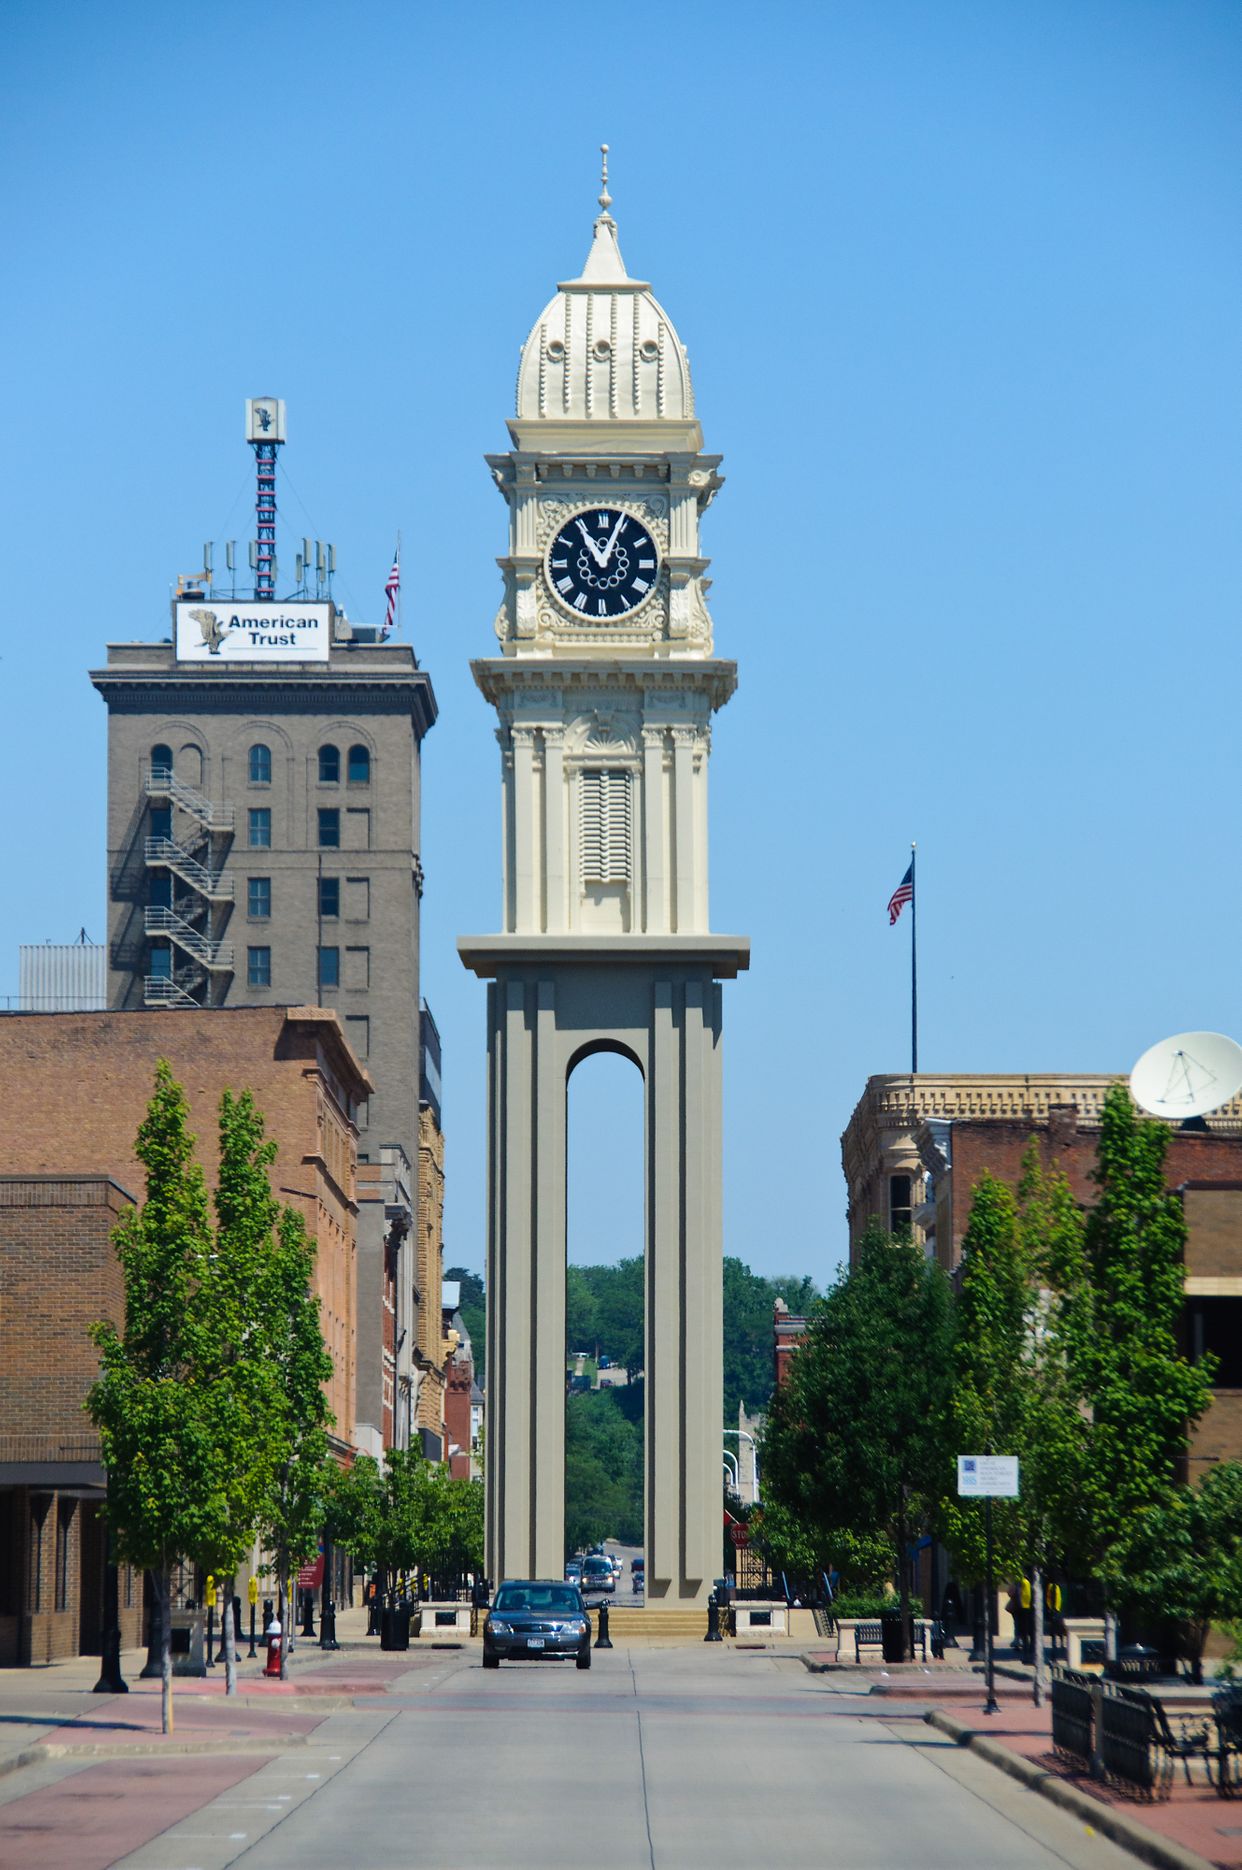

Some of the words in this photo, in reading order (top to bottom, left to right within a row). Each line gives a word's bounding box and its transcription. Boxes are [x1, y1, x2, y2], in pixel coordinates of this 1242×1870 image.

[597, 512, 609, 528] XII
[558, 535, 573, 548] X
[633, 536, 647, 548] II
[639, 559, 654, 569] III
[556, 575, 574, 594] VIII
[573, 592, 588, 610] VII
[598, 599, 607, 614] VI
[620, 594, 631, 609] V
[229, 615, 318, 628] American
[249, 632, 296, 645] Trust
